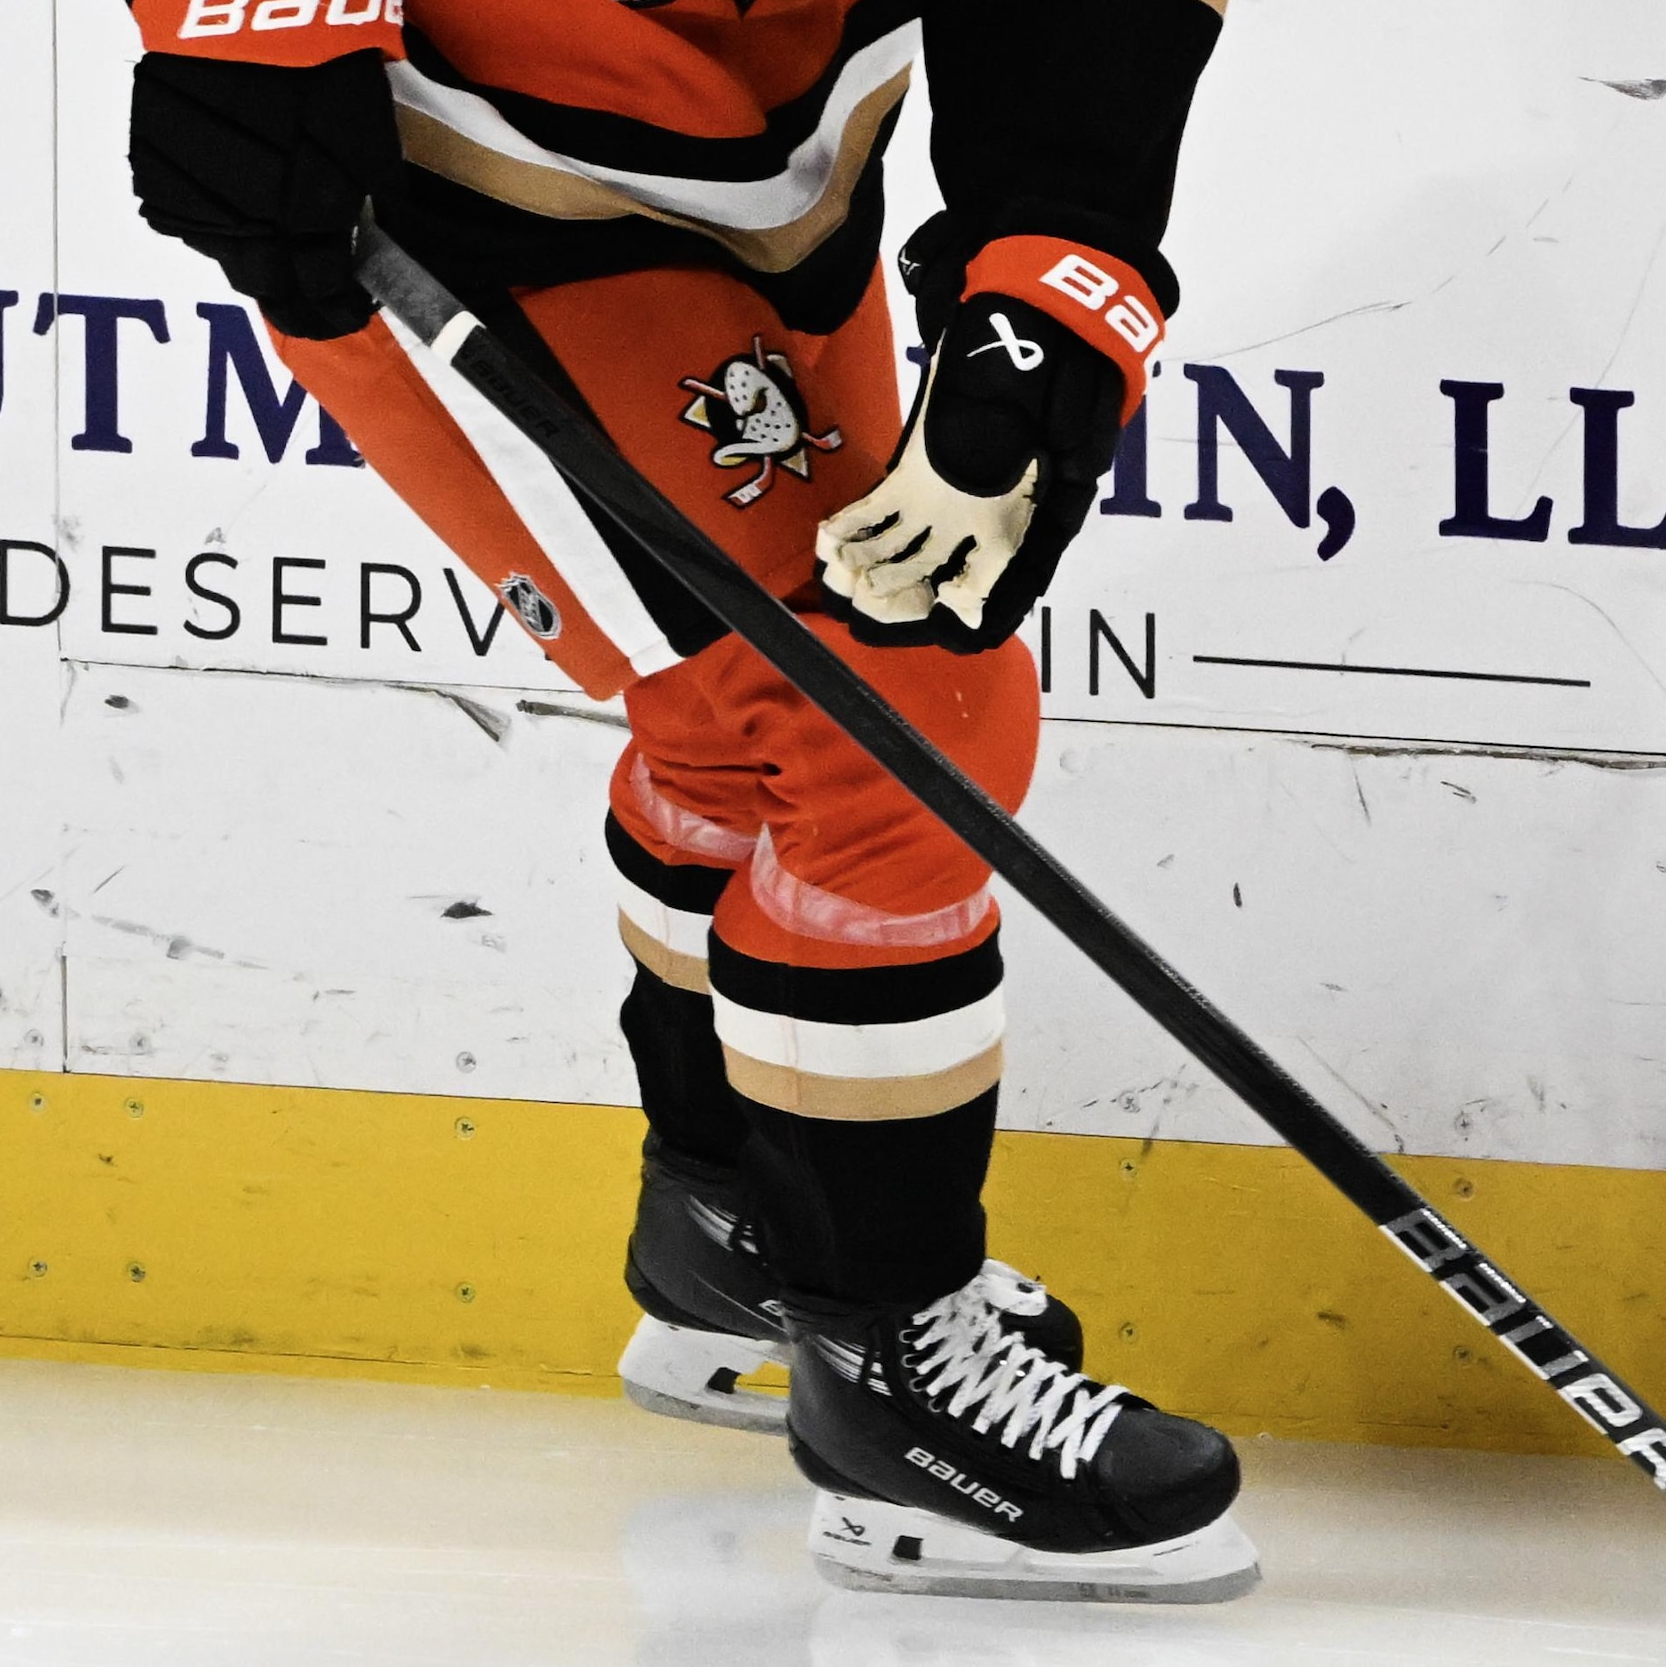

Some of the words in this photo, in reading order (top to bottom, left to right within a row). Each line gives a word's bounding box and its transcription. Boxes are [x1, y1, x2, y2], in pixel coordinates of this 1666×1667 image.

[1097, 362, 1356, 562] IN,
[1038, 605, 1159, 699] IN
[903, 1446, 1024, 1523] BAUER
